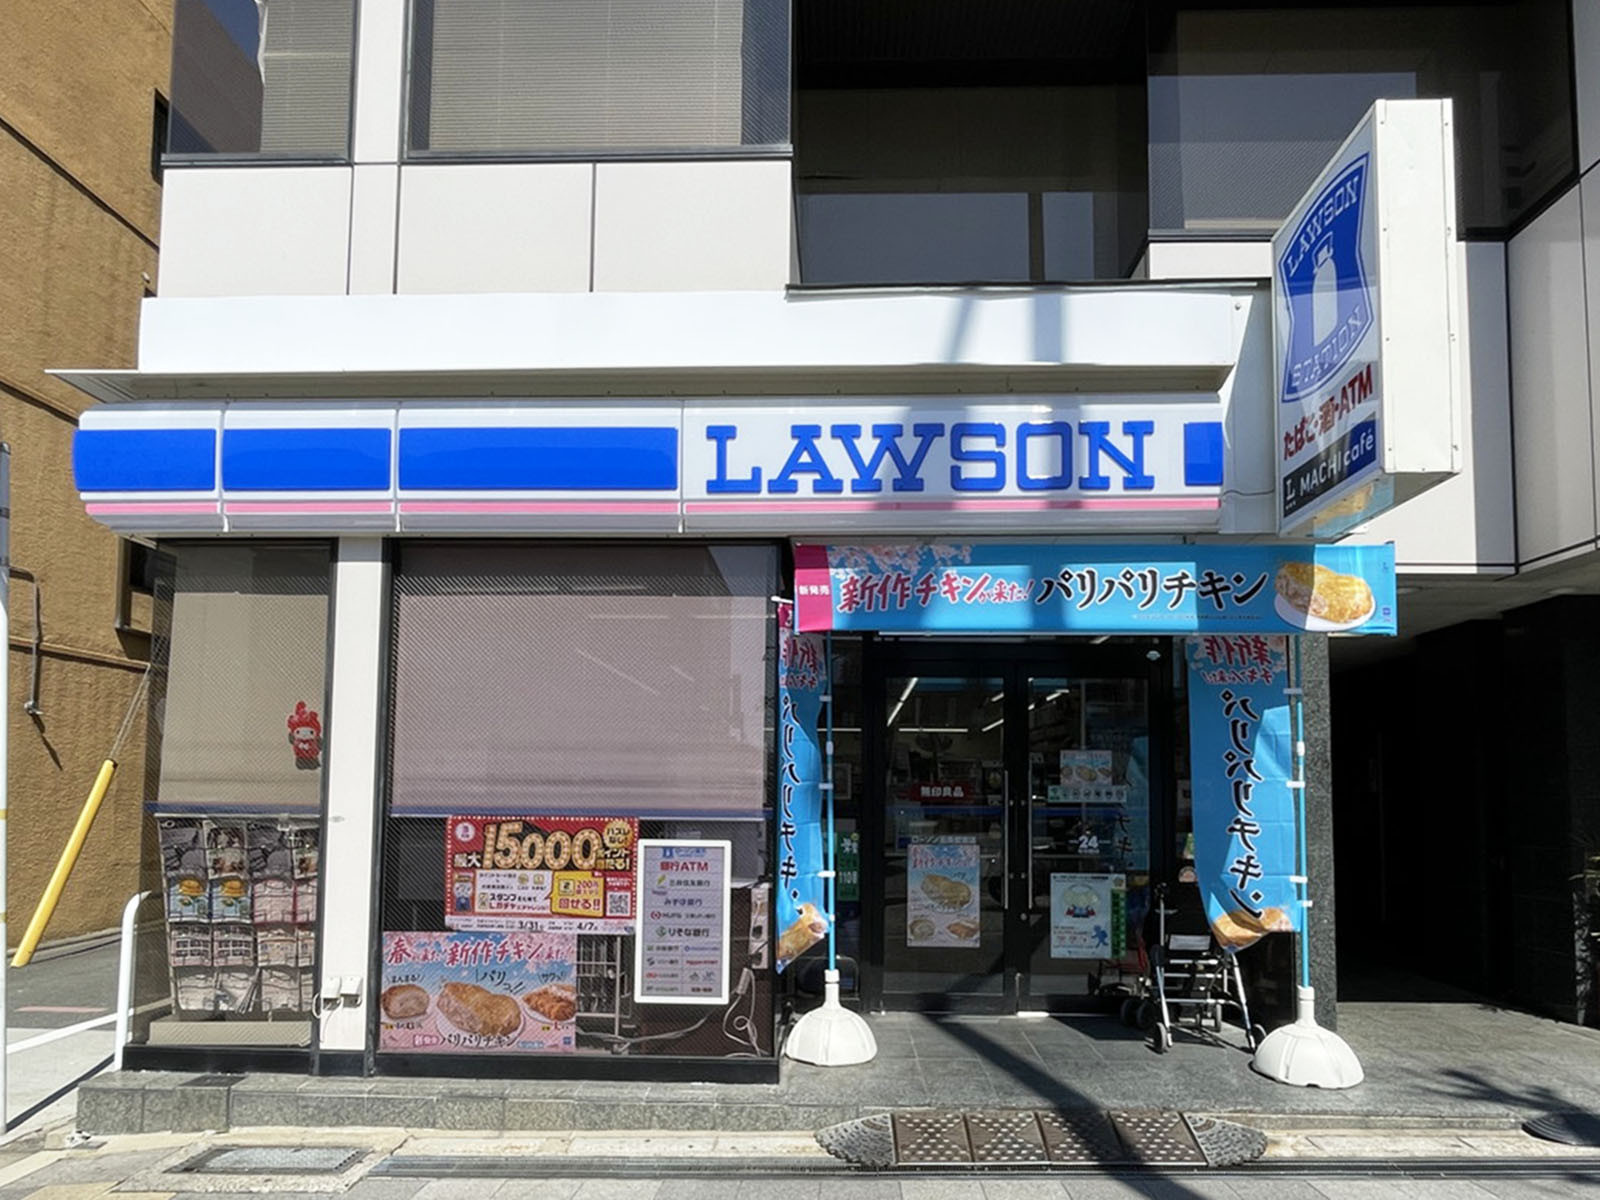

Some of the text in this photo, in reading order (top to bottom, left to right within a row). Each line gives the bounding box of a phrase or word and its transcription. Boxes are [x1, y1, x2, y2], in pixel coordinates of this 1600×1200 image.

[1287, 175, 1361, 277] LAWSON
[1291, 304, 1362, 389] STATION
[706, 421, 1154, 494] LAWSON
[1299, 450, 1341, 497] MACHI
[1343, 428, 1374, 467] café
[799, 585, 830, 596] 新発売
[1036, 567, 1268, 611] パリパリチキン
[920, 785, 965, 798] 無印良品
[454, 852, 481, 868] 最大
[660, 861, 709, 872] 銀行ATM
[668, 927, 710, 937] りそな銀行
